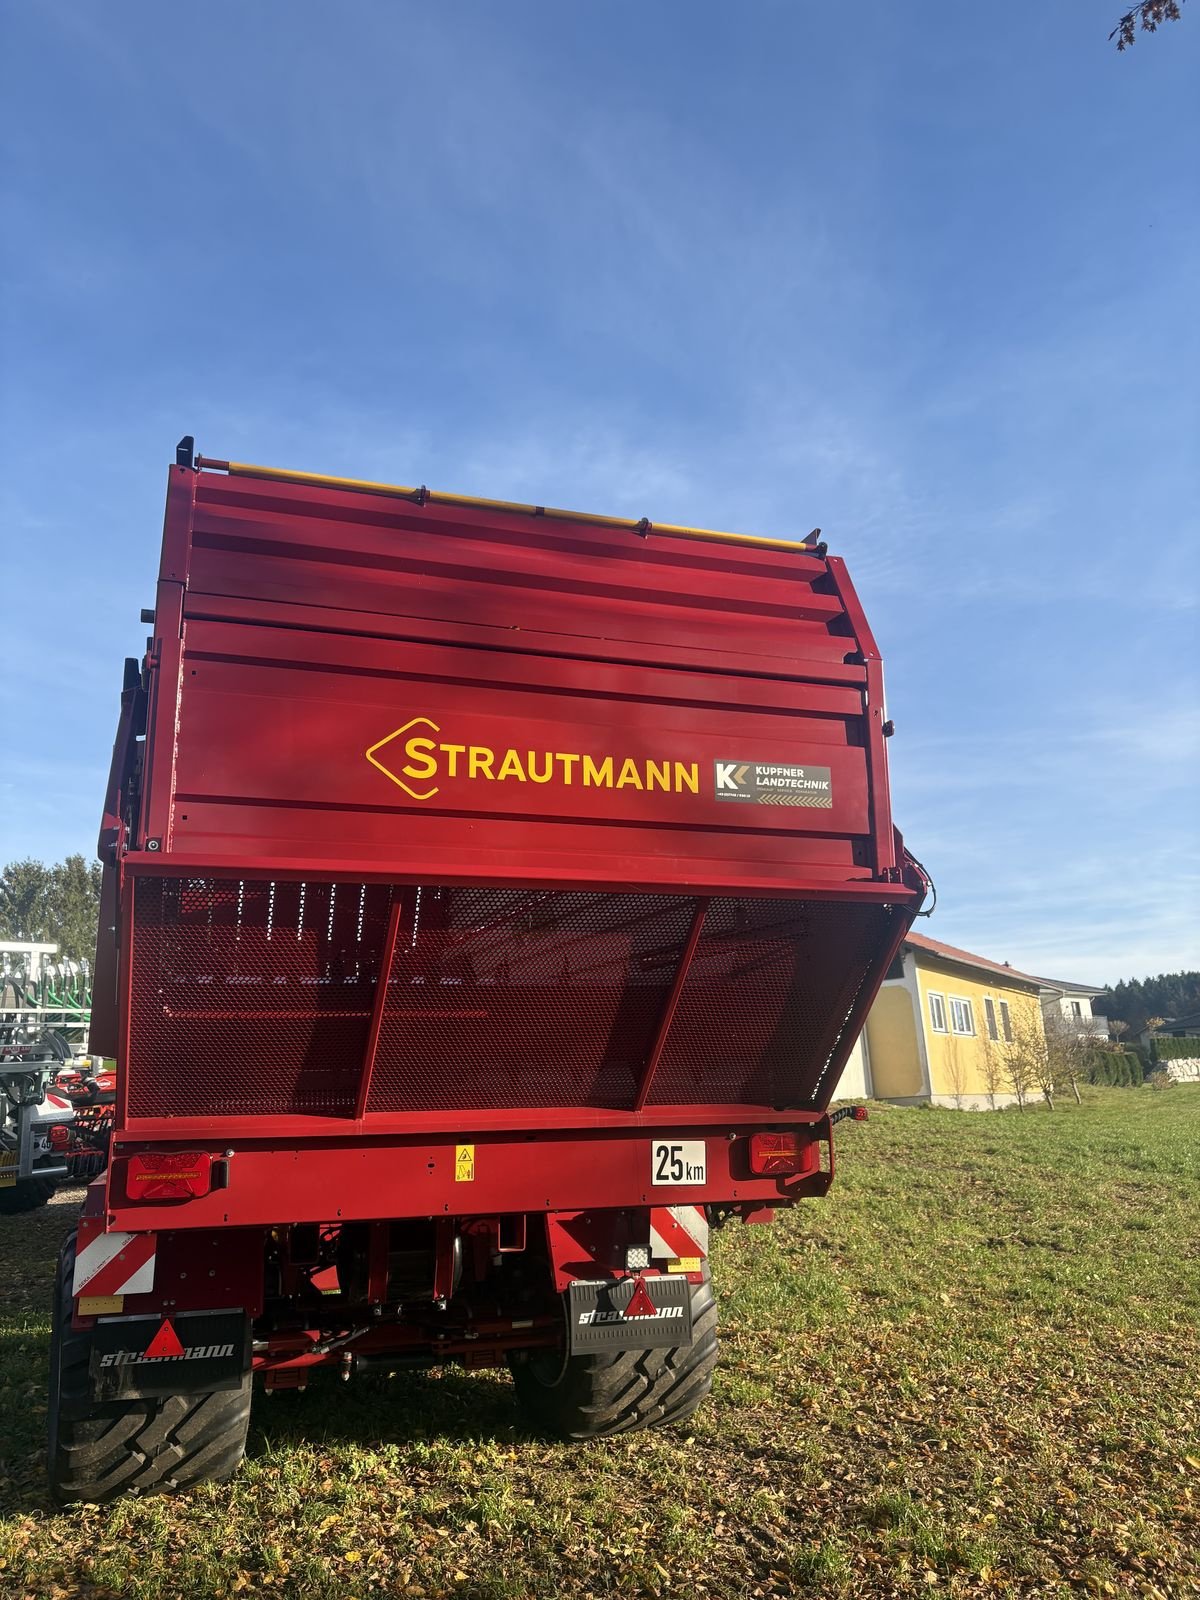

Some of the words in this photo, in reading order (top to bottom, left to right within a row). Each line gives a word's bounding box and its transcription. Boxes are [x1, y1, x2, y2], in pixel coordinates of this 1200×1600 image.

[402, 737, 699, 793] STRAUTMANN
[755, 766, 804, 777] KUPFNER
[756, 777, 829, 789] LANDTECHNIK
[656, 1145, 683, 1181] 25
[686, 1162, 704, 1180] km
